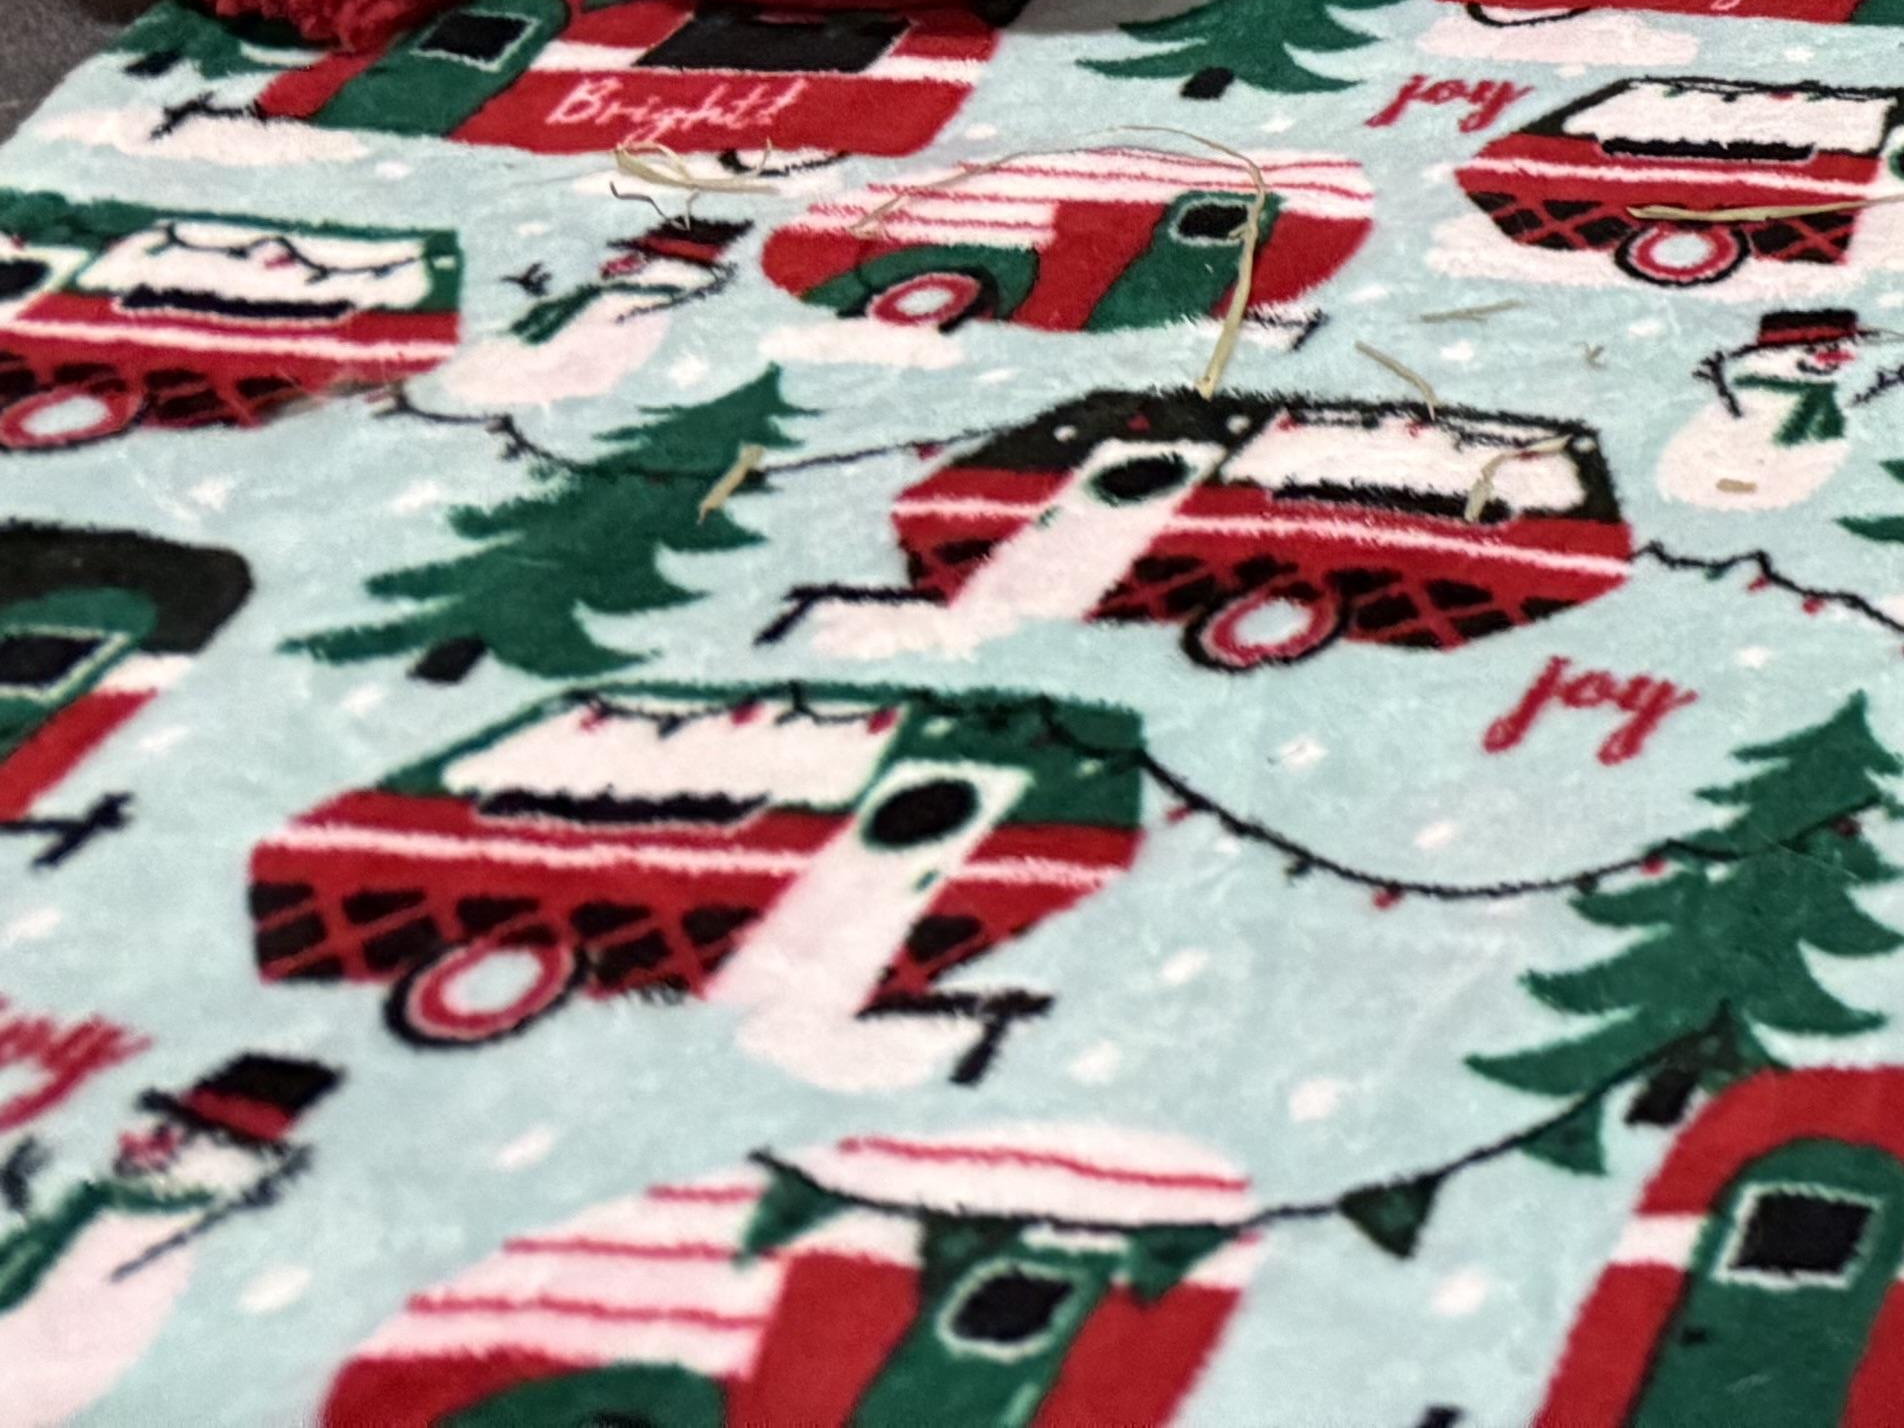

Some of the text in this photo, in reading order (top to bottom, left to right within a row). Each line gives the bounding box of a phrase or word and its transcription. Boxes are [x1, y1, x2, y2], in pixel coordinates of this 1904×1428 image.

[546, 74, 808, 134] Bright!
[1364, 72, 1538, 129] joy
[1483, 655, 1697, 766] joy
